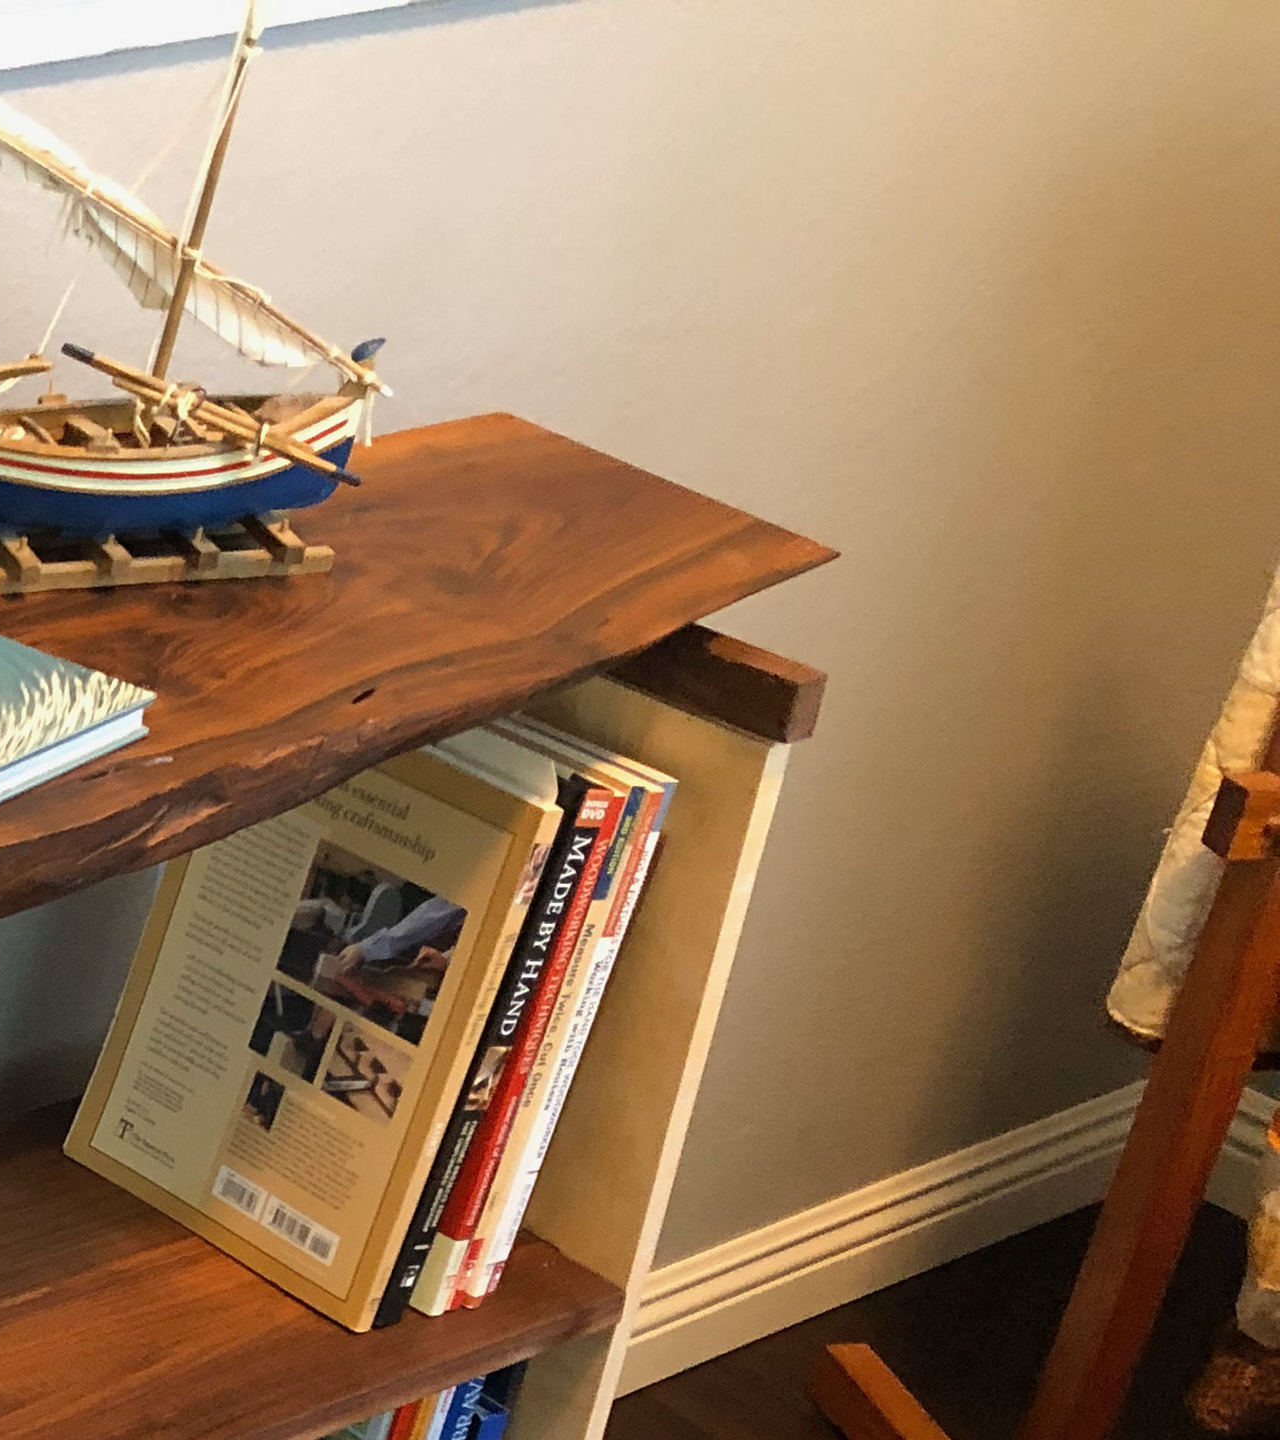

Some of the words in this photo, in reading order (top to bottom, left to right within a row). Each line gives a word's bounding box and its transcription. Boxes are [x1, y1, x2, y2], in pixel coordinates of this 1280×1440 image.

[580, 809, 607, 821] DVD
[545, 834, 593, 915] MADE
[555, 838, 612, 969] WOODWORKING
[534, 921, 556, 951] BY
[574, 923, 596, 982] Measure
[501, 958, 544, 1037] HAND
[576, 960, 607, 1018] Working
[519, 968, 567, 1075] TECHNIQUES
[546, 992, 572, 1038] Twice,
[566, 1022, 584, 1054] with
[579, 1003, 598, 1038] HAND
[536, 1041, 554, 1067] Cut
[522, 1071, 544, 1109] Once
[542, 1058, 569, 1112] Routers
